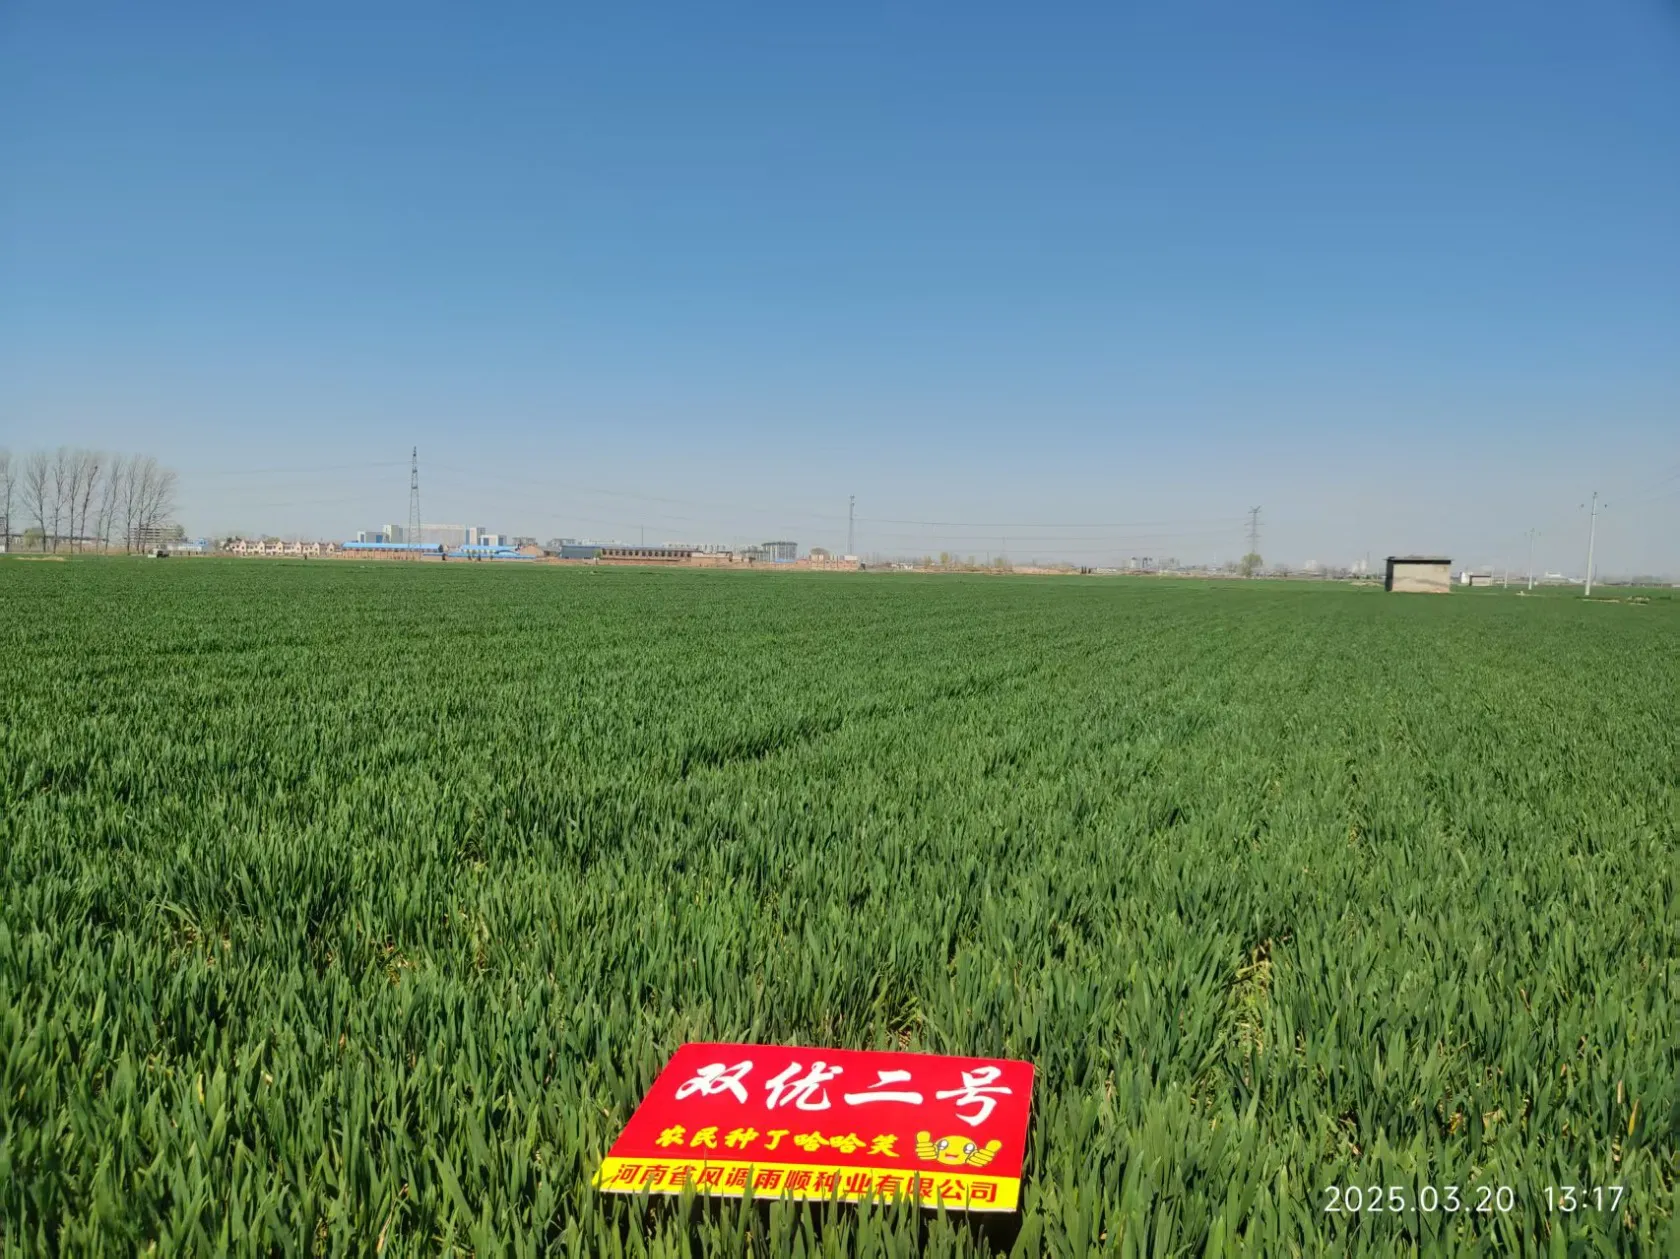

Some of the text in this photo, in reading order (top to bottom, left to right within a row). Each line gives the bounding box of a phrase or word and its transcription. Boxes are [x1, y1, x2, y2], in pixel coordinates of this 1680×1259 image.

[674, 1060, 1013, 1127] 双优二号
[612, 1163, 999, 1203] 河南省风调雨顺种业有限公司
